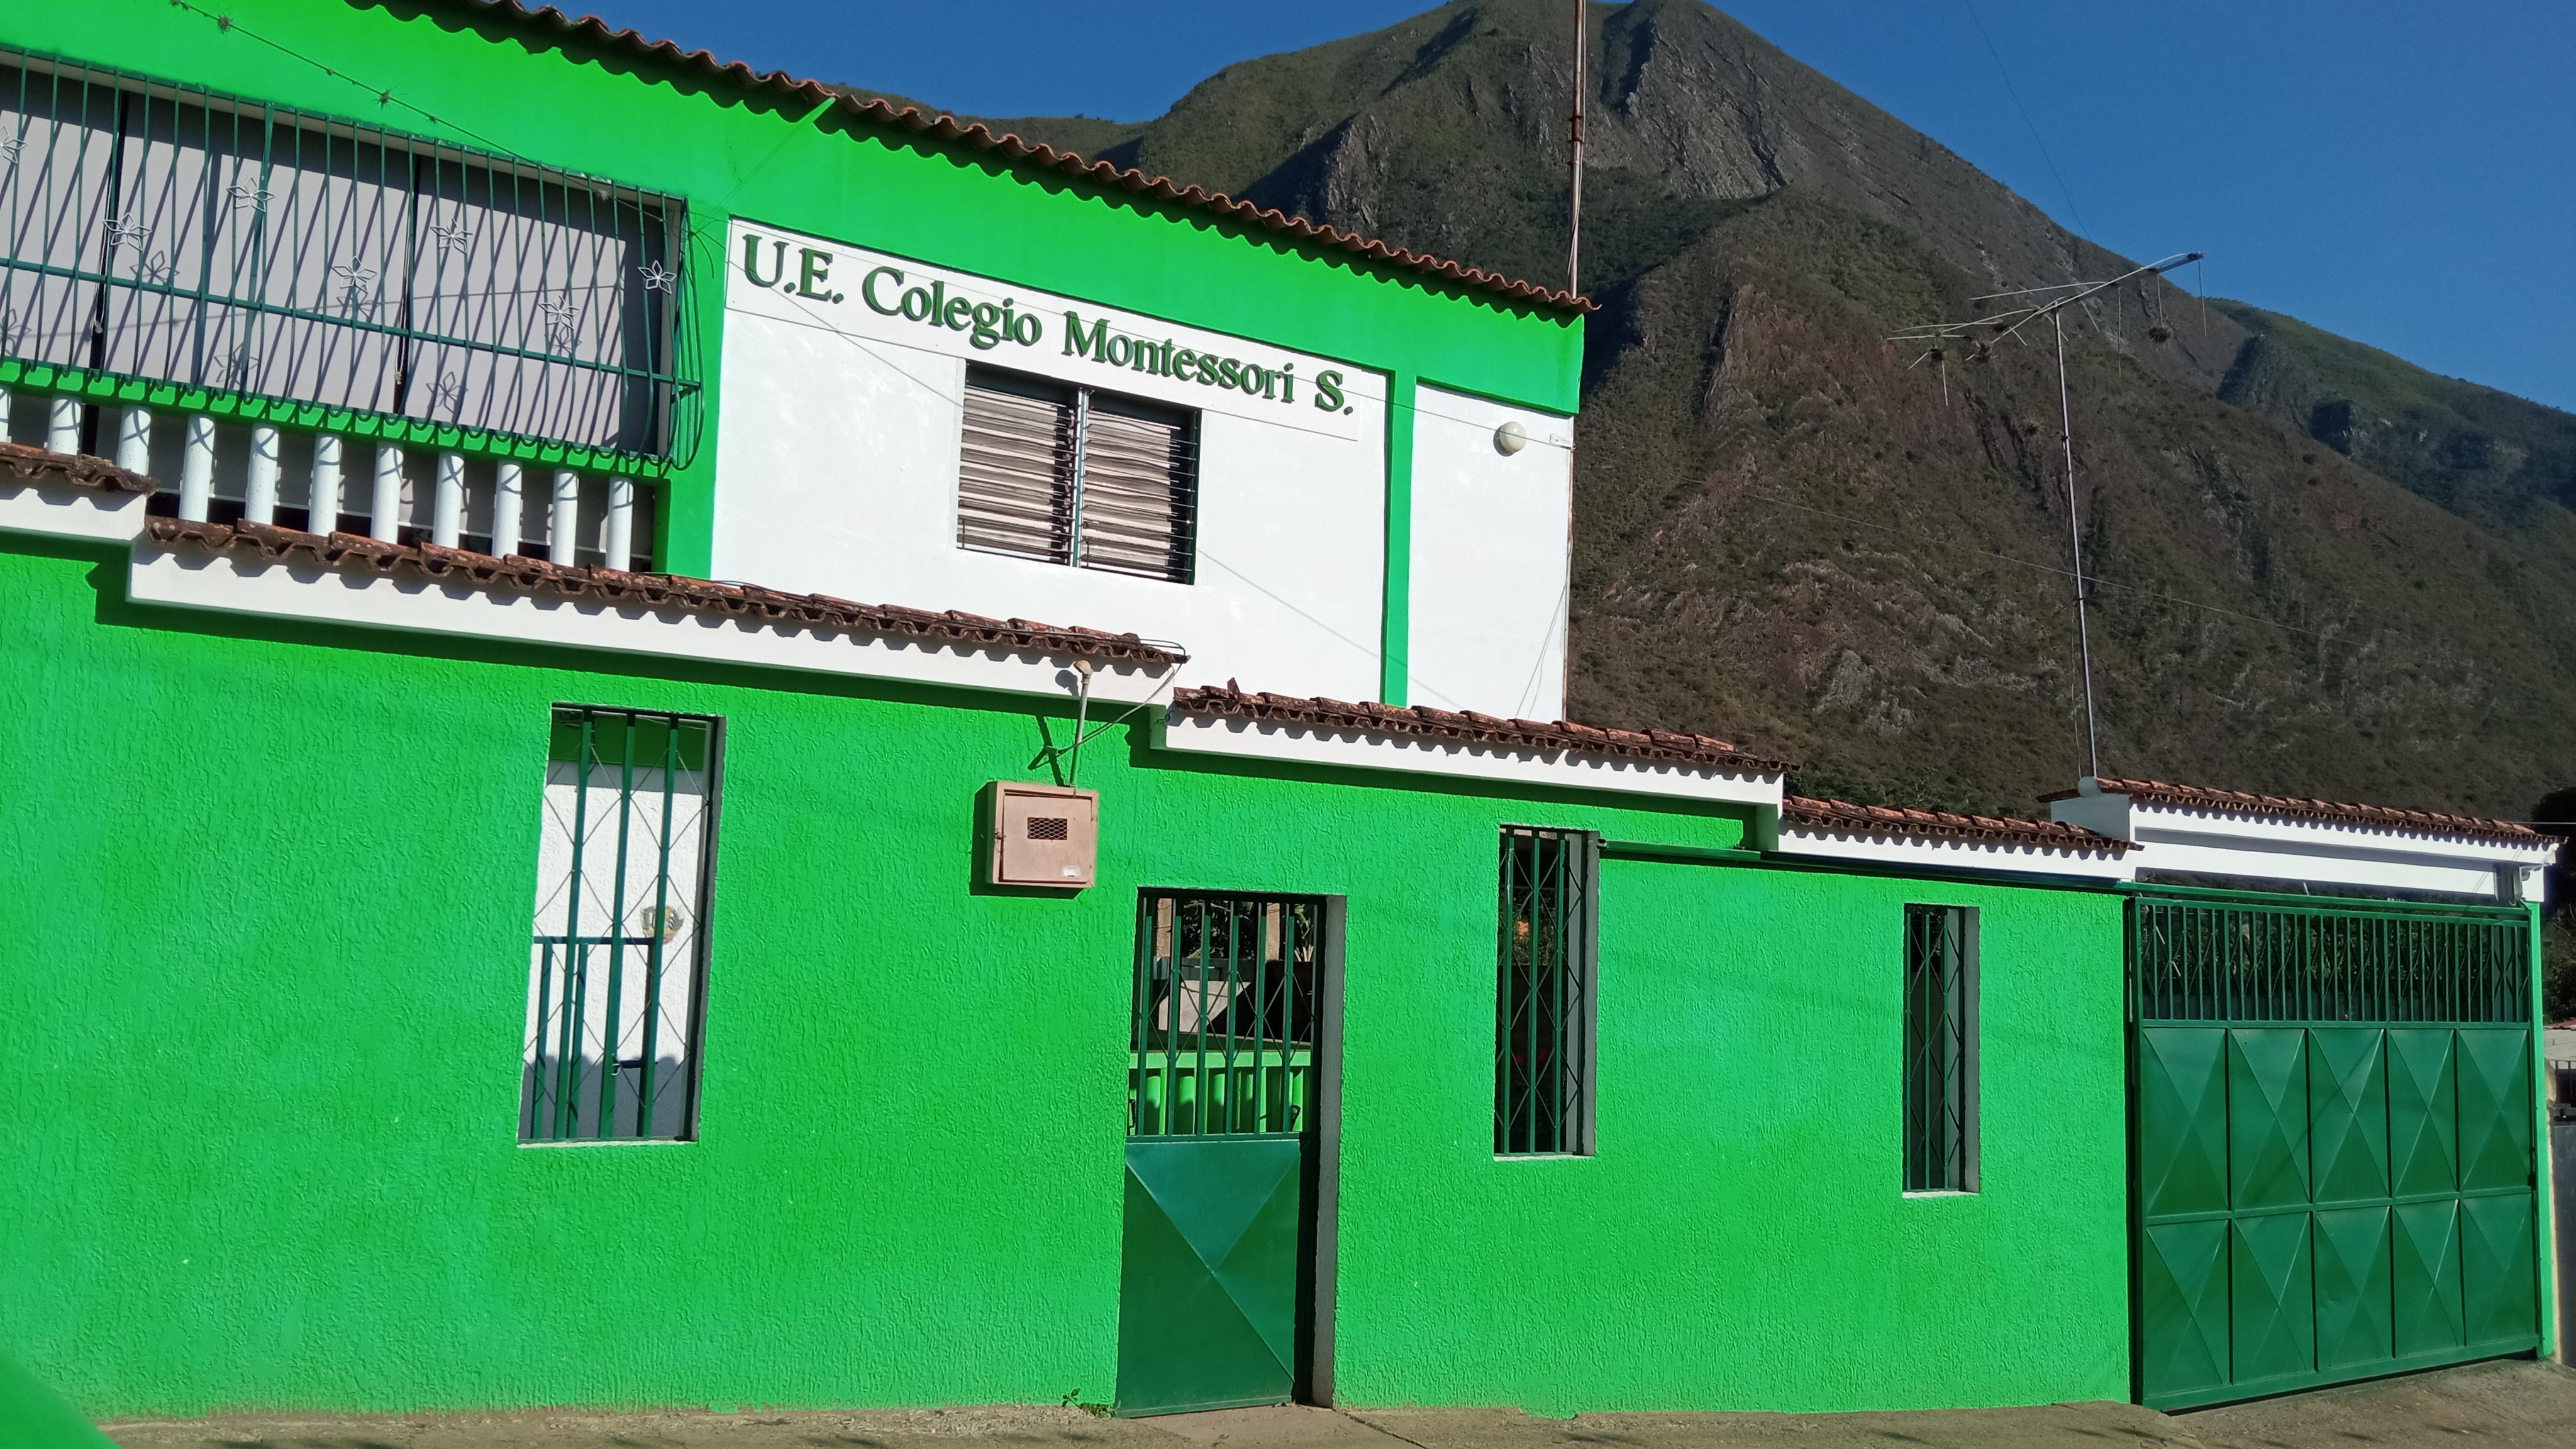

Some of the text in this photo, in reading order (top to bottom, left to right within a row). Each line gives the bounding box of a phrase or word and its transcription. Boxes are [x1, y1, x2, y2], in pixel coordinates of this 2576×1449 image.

[743, 233, 1355, 415] U.E. Colegio Montessori S.
